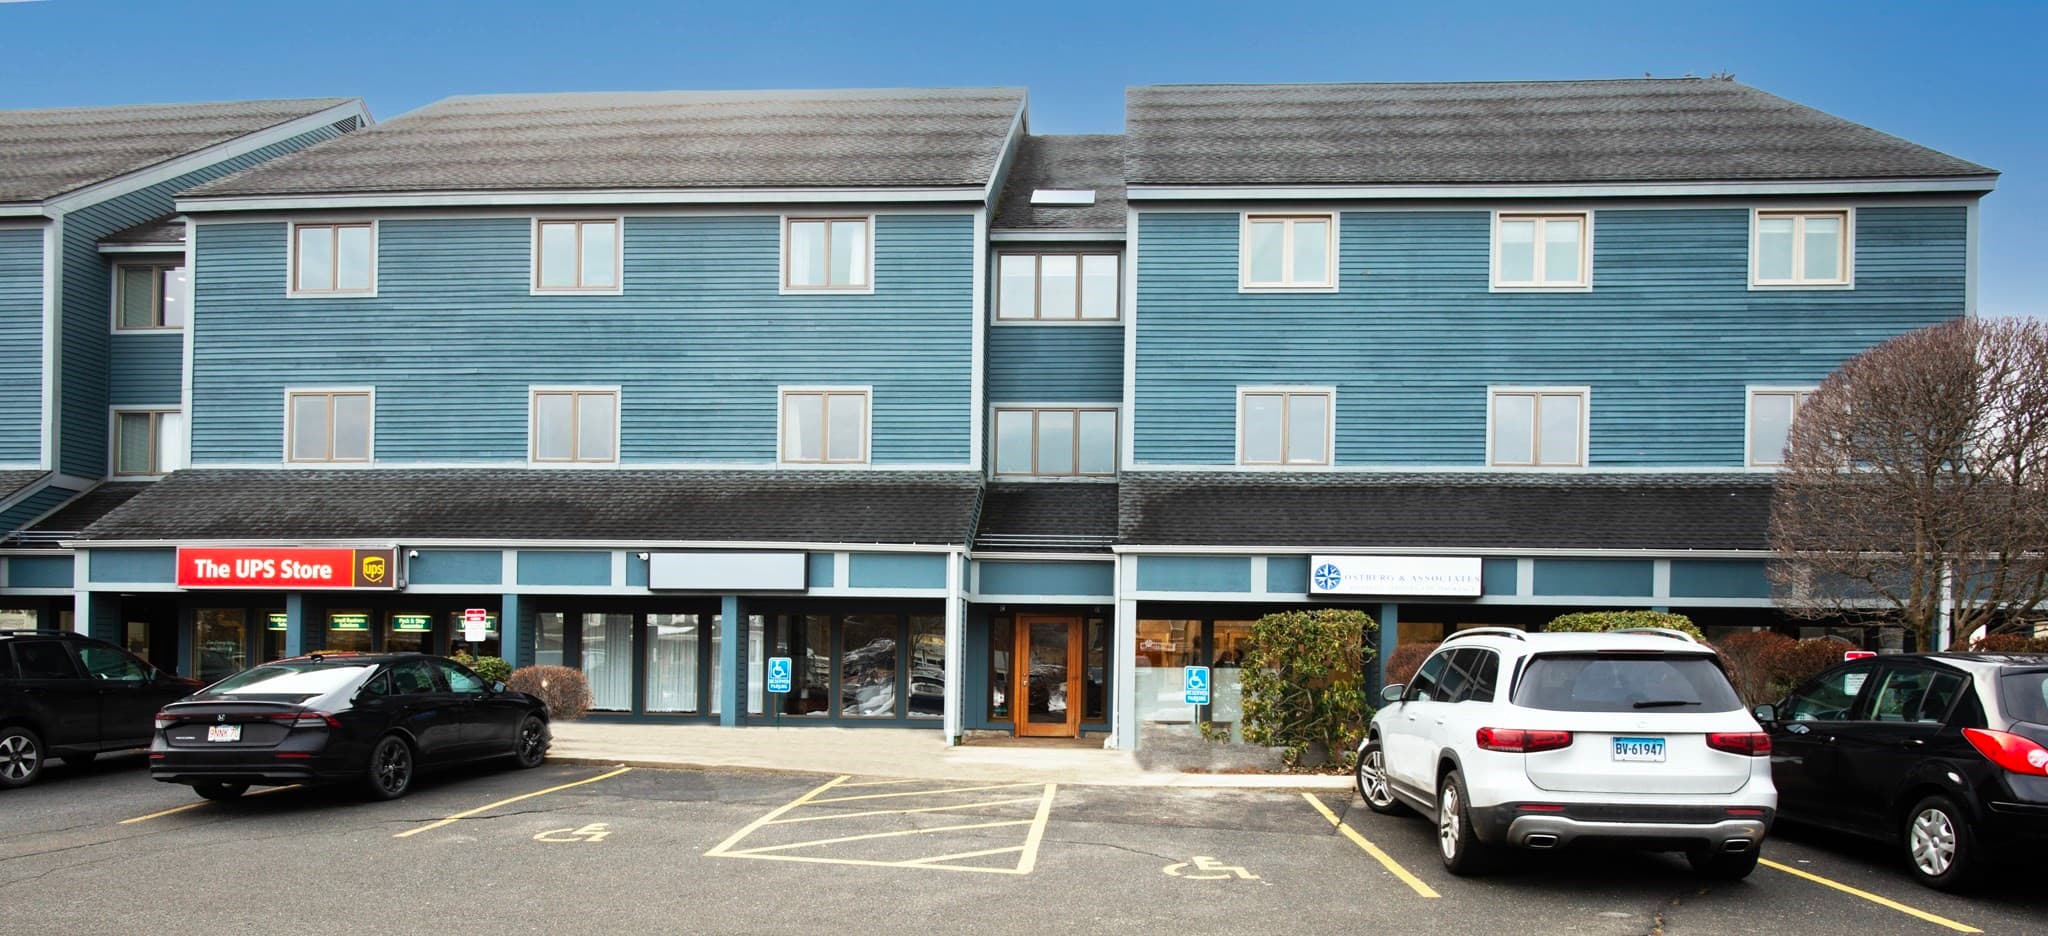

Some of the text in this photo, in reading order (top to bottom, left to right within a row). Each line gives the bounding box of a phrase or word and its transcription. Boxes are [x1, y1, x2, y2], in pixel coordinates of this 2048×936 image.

[194, 558, 332, 579] The UPS Store
[365, 564, 384, 578] ups
[1344, 574, 1394, 582] OSTBERG
[1412, 575, 1481, 583] ASSOCIATES
